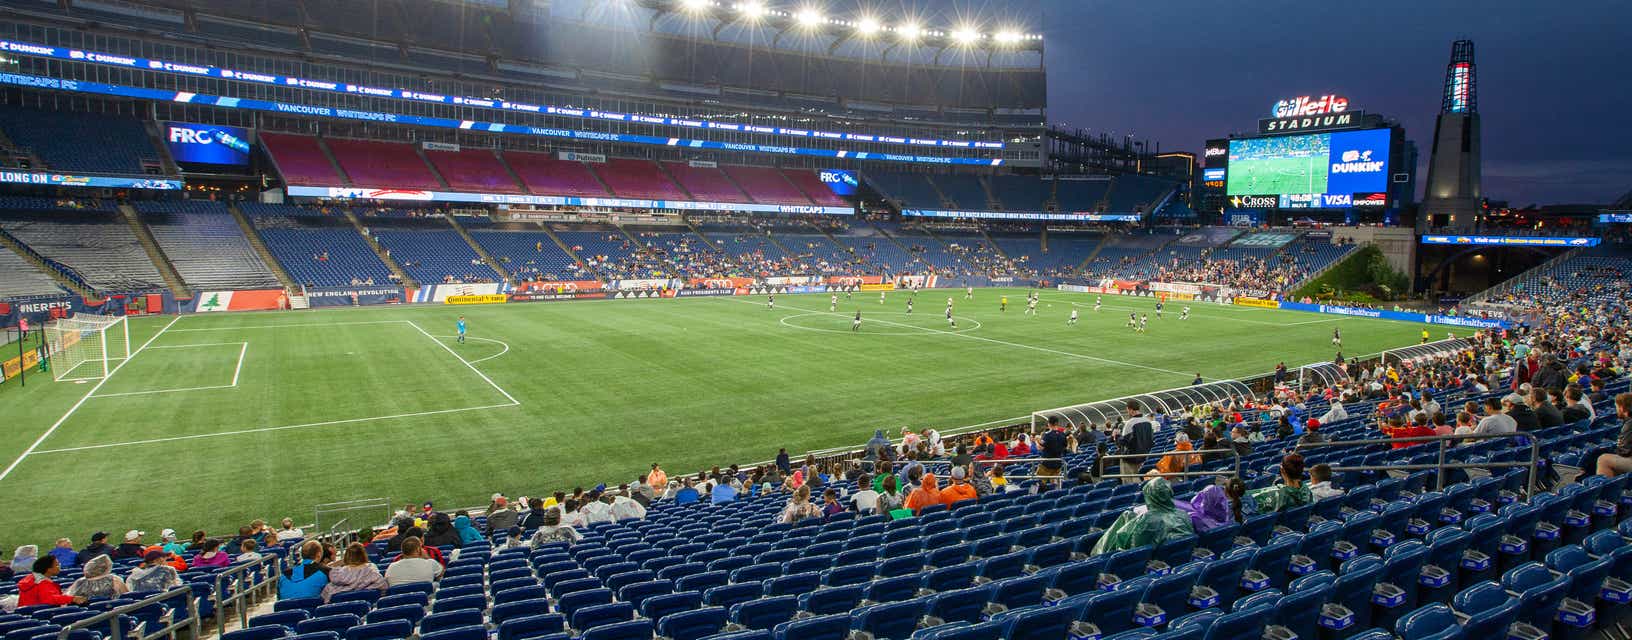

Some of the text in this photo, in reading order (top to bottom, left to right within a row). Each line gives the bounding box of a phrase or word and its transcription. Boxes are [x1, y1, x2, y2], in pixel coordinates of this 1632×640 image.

[0, 73, 77, 90] HITECAPS FC
[1272, 95, 1348, 118] Gillette
[278, 104, 397, 122] VANCOUVER WHITECAPS FC
[1268, 114, 1351, 130] STADIUM
[532, 128, 570, 137] VANCOUVER
[574, 130, 610, 140] WHITECAPS
[724, 143, 756, 151] VANCOUVER
[1332, 162, 1384, 174] DUNKIN'
[0, 172, 48, 183] LONG ON
[1324, 195, 1350, 204] VISA
[780, 206, 823, 214] WHITECAPS
[1326, 306, 1380, 317] UnitedHealthcare
[1434, 316, 1500, 328] UnitedHealthcare
